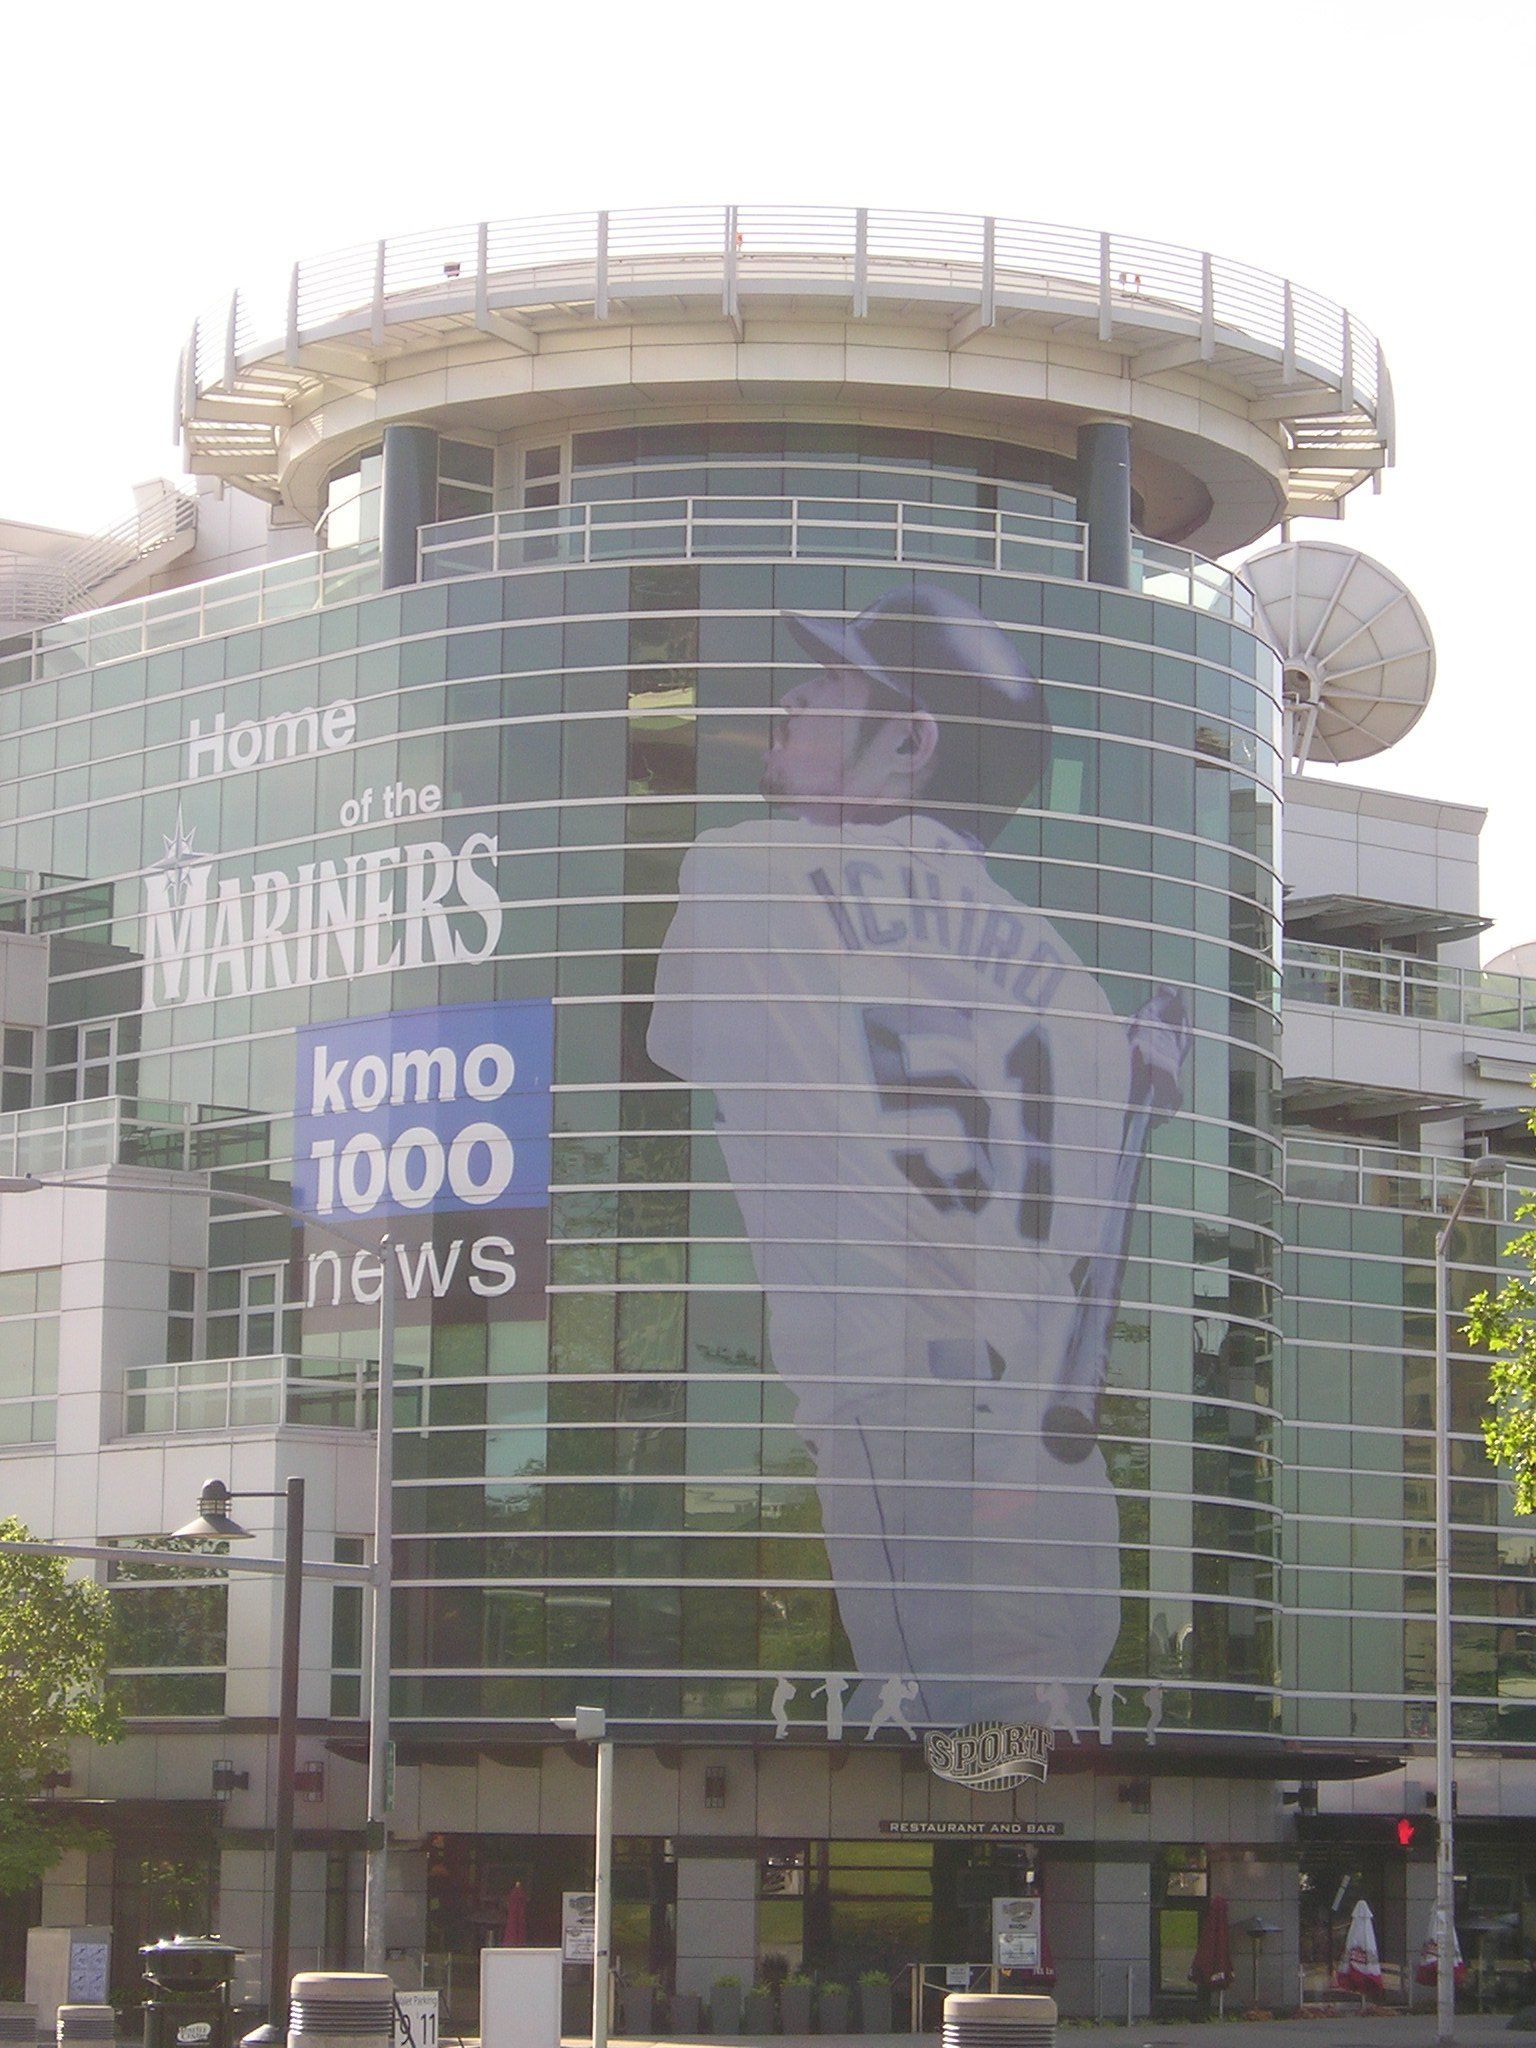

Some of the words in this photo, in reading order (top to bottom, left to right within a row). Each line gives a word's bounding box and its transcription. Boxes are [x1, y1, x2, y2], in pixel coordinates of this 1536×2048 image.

[187, 698, 357, 780] Home
[339, 786, 372, 827] of
[382, 782, 442, 818] the
[141, 832, 503, 1012] MARINERS
[809, 859, 1069, 1009] ICHIRO
[310, 1042, 515, 1117] komo
[862, 1004, 1056, 1242] 51
[310, 1122, 515, 1216] 1000
[306, 1235, 517, 1308] news
[924, 1722, 1055, 1776] SPORT
[889, 1822, 985, 1834] RESTAURANT
[989, 1823, 1021, 1834] AND
[1026, 1824, 1057, 1835] BAR
